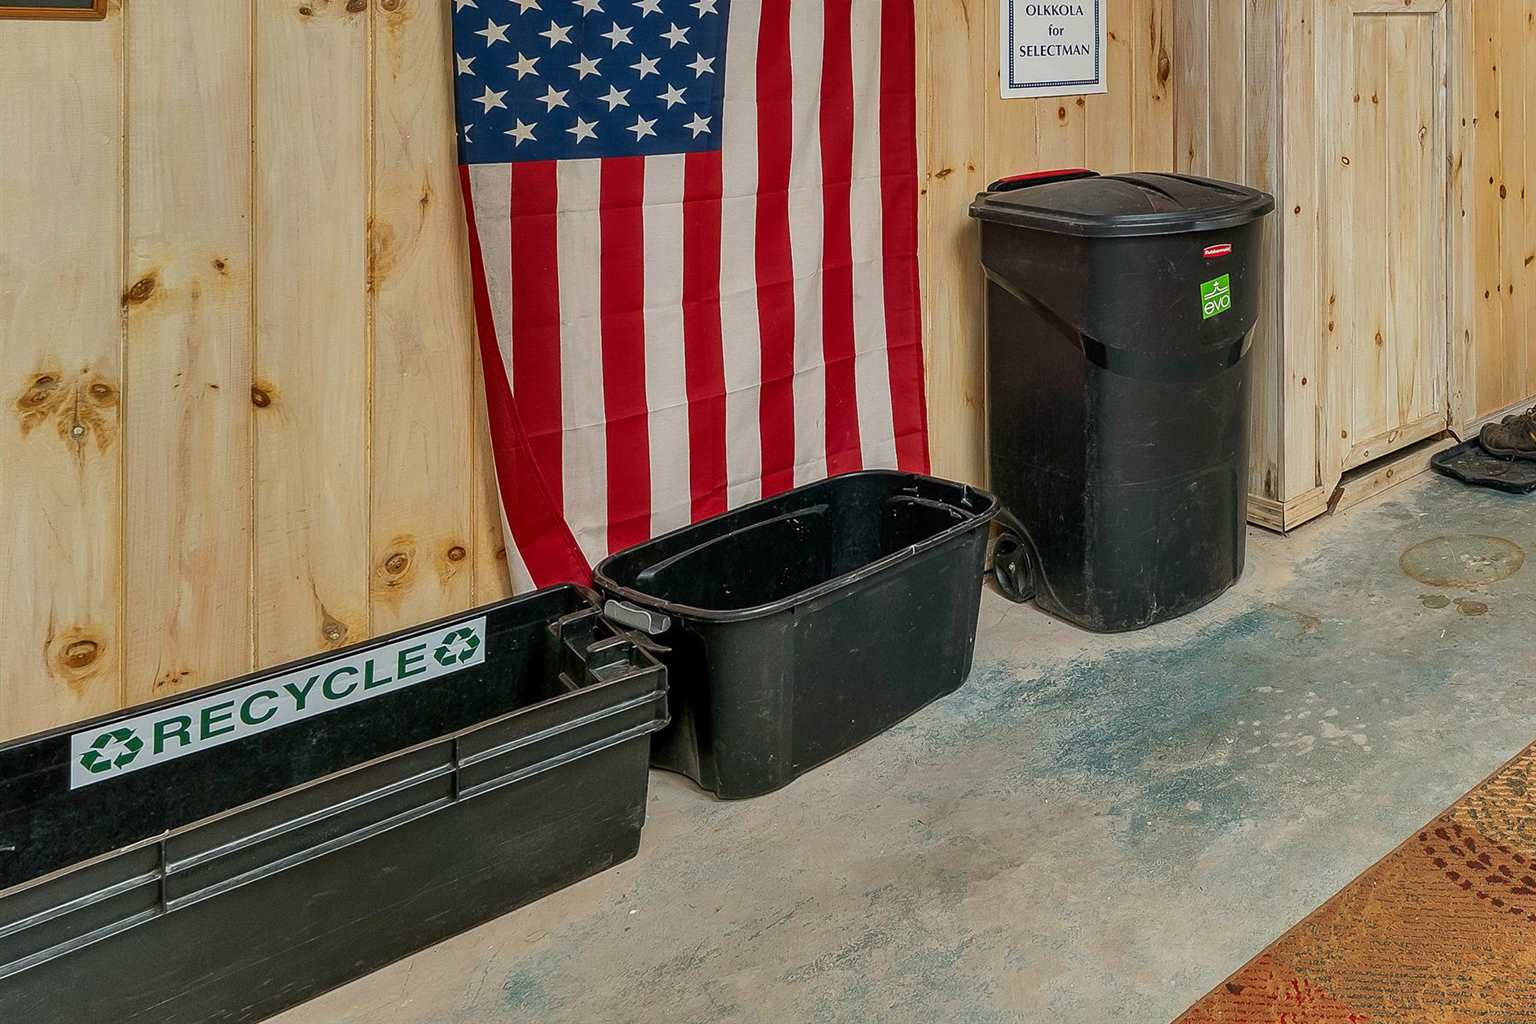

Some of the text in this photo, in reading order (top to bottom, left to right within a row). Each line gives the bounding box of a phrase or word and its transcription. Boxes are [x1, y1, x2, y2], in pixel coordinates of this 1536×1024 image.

[1026, 4, 1084, 17] OLKKOLA
[1048, 24, 1065, 37] for
[1019, 44, 1090, 57] SELECTMAN
[1204, 294, 1231, 314] evo
[153, 643, 427, 756] RECYCLE
